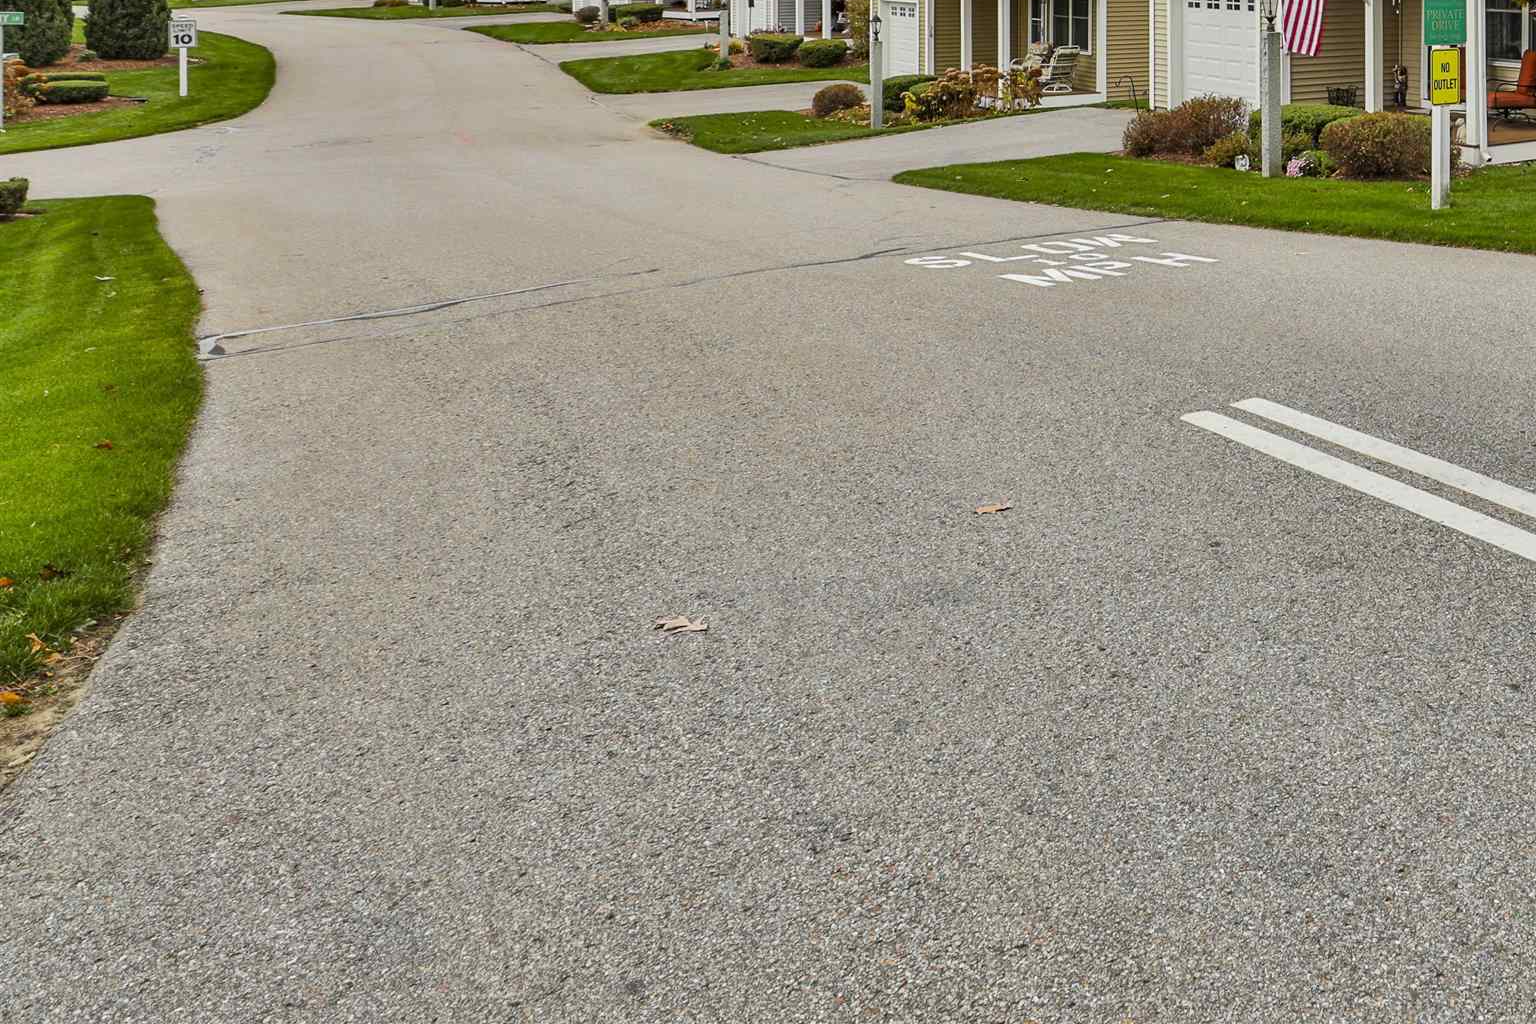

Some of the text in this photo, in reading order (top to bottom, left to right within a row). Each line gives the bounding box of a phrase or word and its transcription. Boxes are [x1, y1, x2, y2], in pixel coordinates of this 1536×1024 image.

[1426, 8, 1465, 20] PRIVATE
[1431, 19, 1459, 32] DRIVE
[173, 33, 193, 45] 10
[1440, 62, 1450, 73] NO
[1433, 78, 1457, 90] OUTLET
[904, 233, 1159, 269] SLOW
[1031, 253, 1108, 266] 10
[999, 252, 1222, 288] MPH
